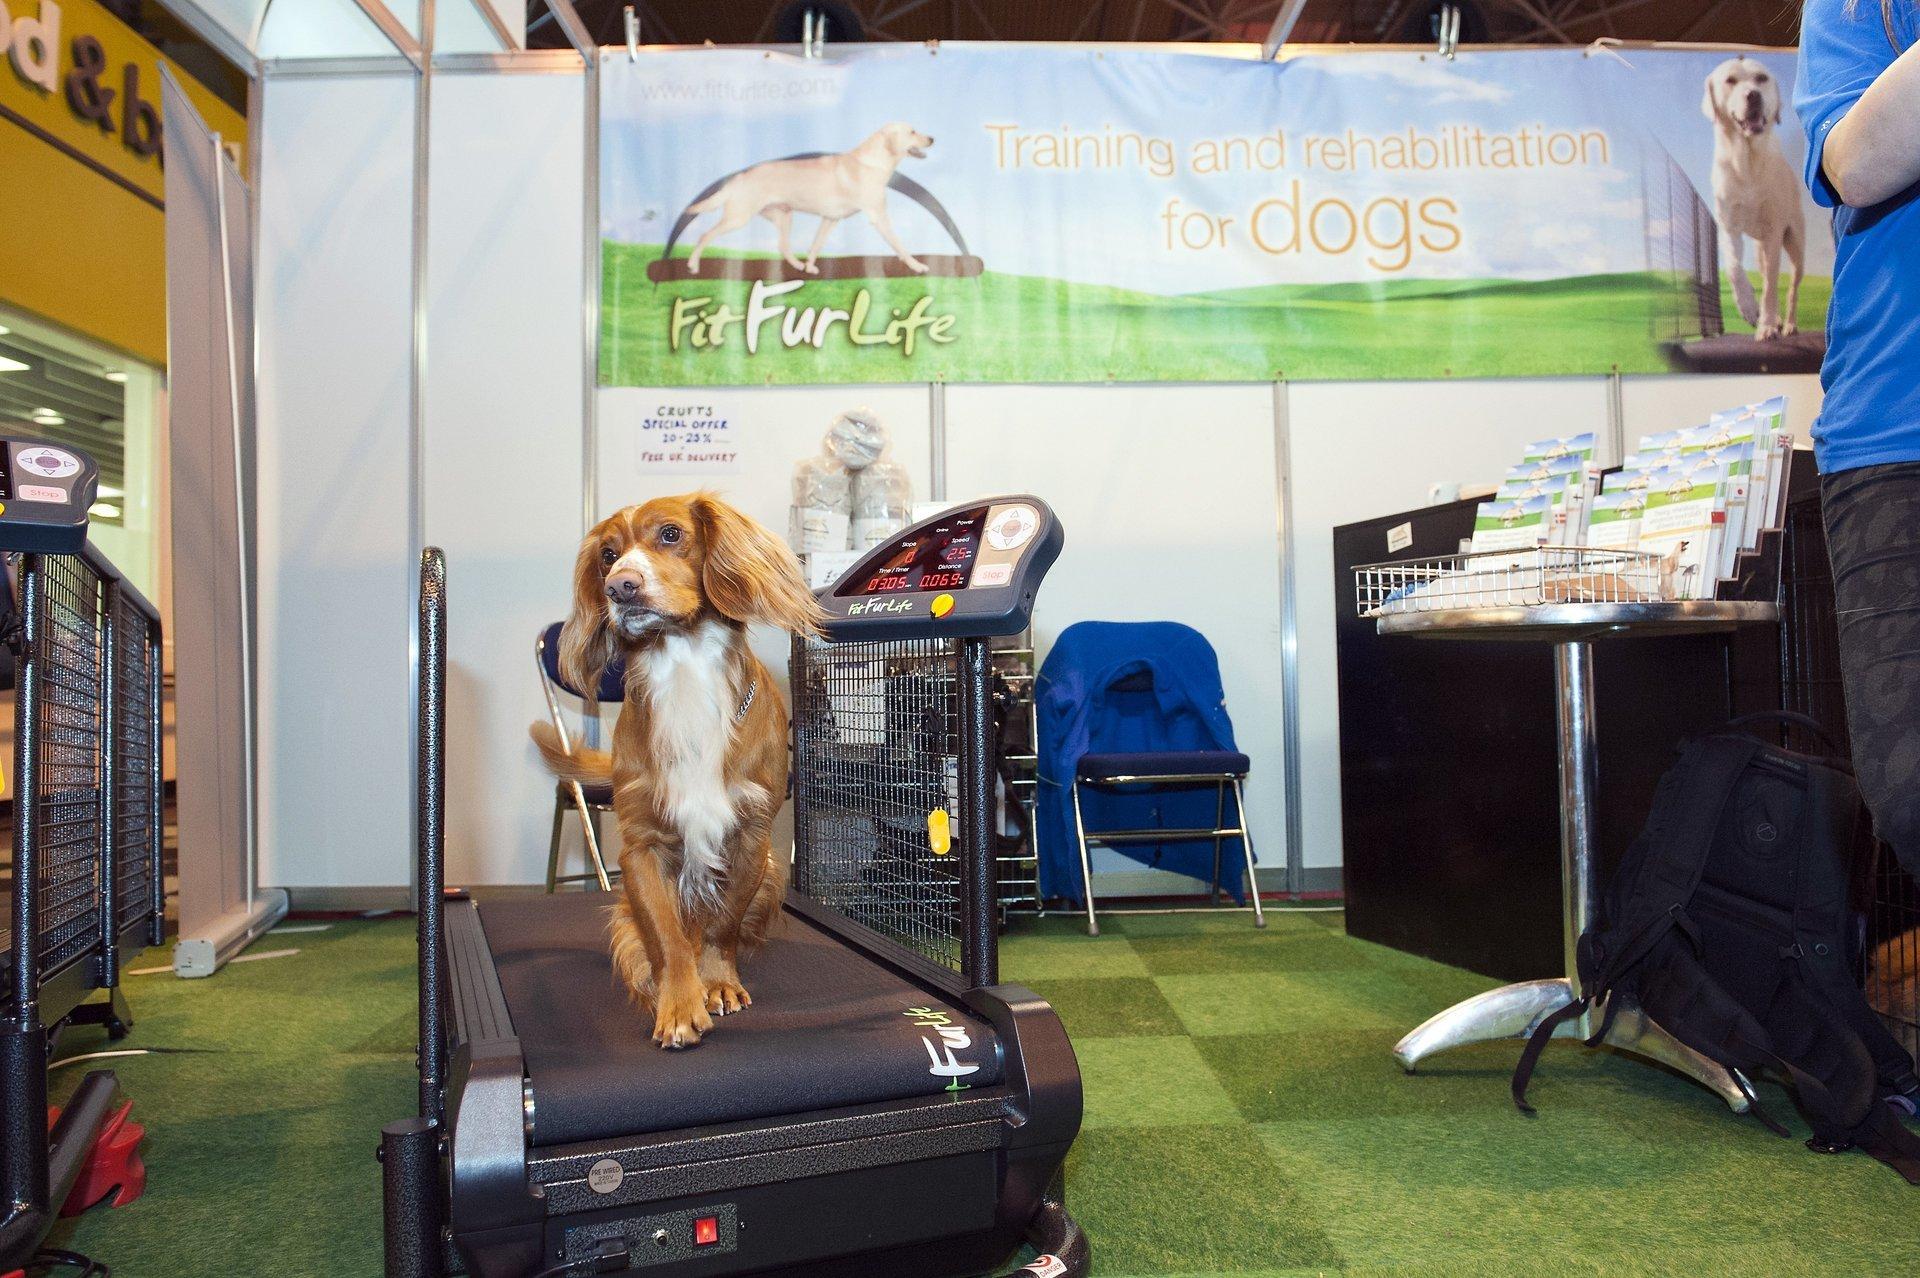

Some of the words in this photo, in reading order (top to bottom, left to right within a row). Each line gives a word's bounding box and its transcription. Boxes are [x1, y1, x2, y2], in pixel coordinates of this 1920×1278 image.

[0, 0, 61, 94] d
[66, 36, 115, 131] &
[123, 63, 164, 168] b
[641, 78, 835, 102] www.fitfurlife.com
[984, 124, 1175, 177] Training
[1192, 129, 1286, 174] and
[1305, 125, 1609, 171] rehabilitation
[1161, 199, 1234, 250] for
[1252, 179, 1461, 272] dogs
[657, 406, 713, 417] CRUFTS
[642, 419, 687, 429] SPECIAL
[692, 420, 728, 429] OFFER
[641, 451, 663, 462] FREE
[687, 452, 737, 462] DELIVERY
[30, 489, 59, 498] Stop
[951, 536, 971, 544] Speed
[591, 1168, 601, 1176] PRE
[602, 1166, 620, 1174] WIRED
[1040, 1262, 1063, 1278] DANGER
